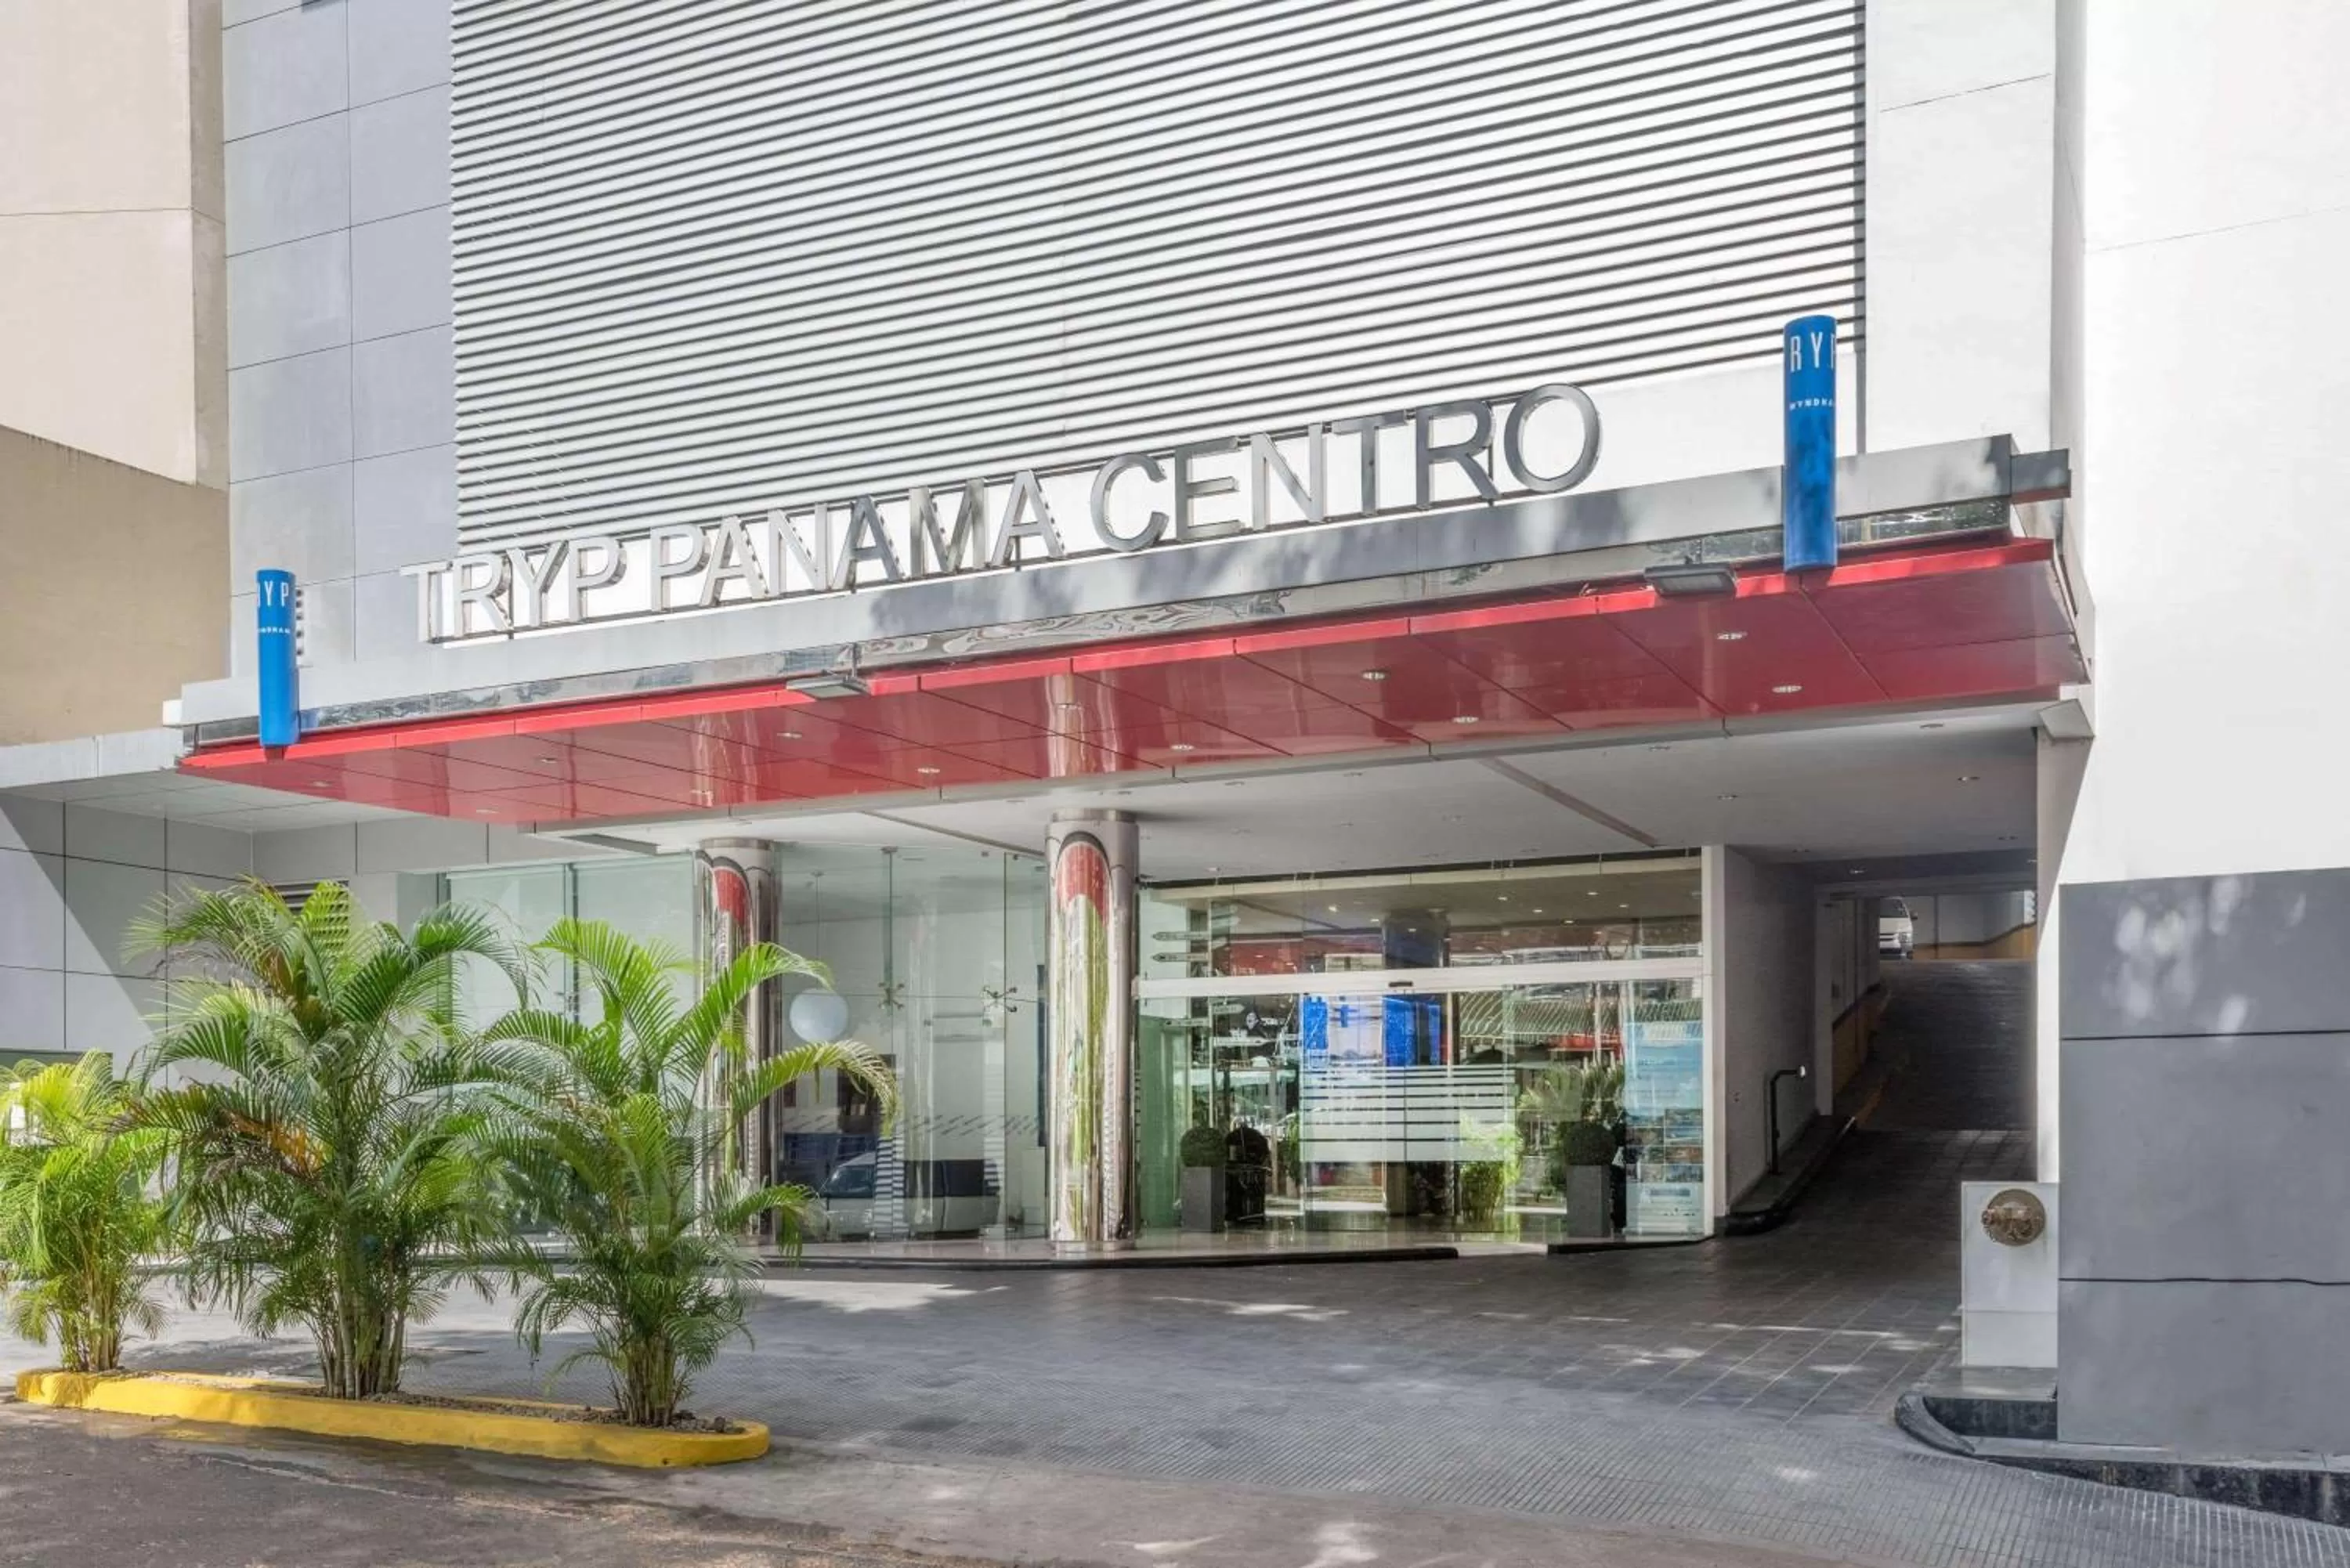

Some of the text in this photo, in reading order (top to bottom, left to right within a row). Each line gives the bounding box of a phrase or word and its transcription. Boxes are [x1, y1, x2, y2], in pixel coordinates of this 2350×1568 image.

[400, 383, 1601, 643] TRYP PANAMA CENTRO
[258, 580, 290, 608] YP
